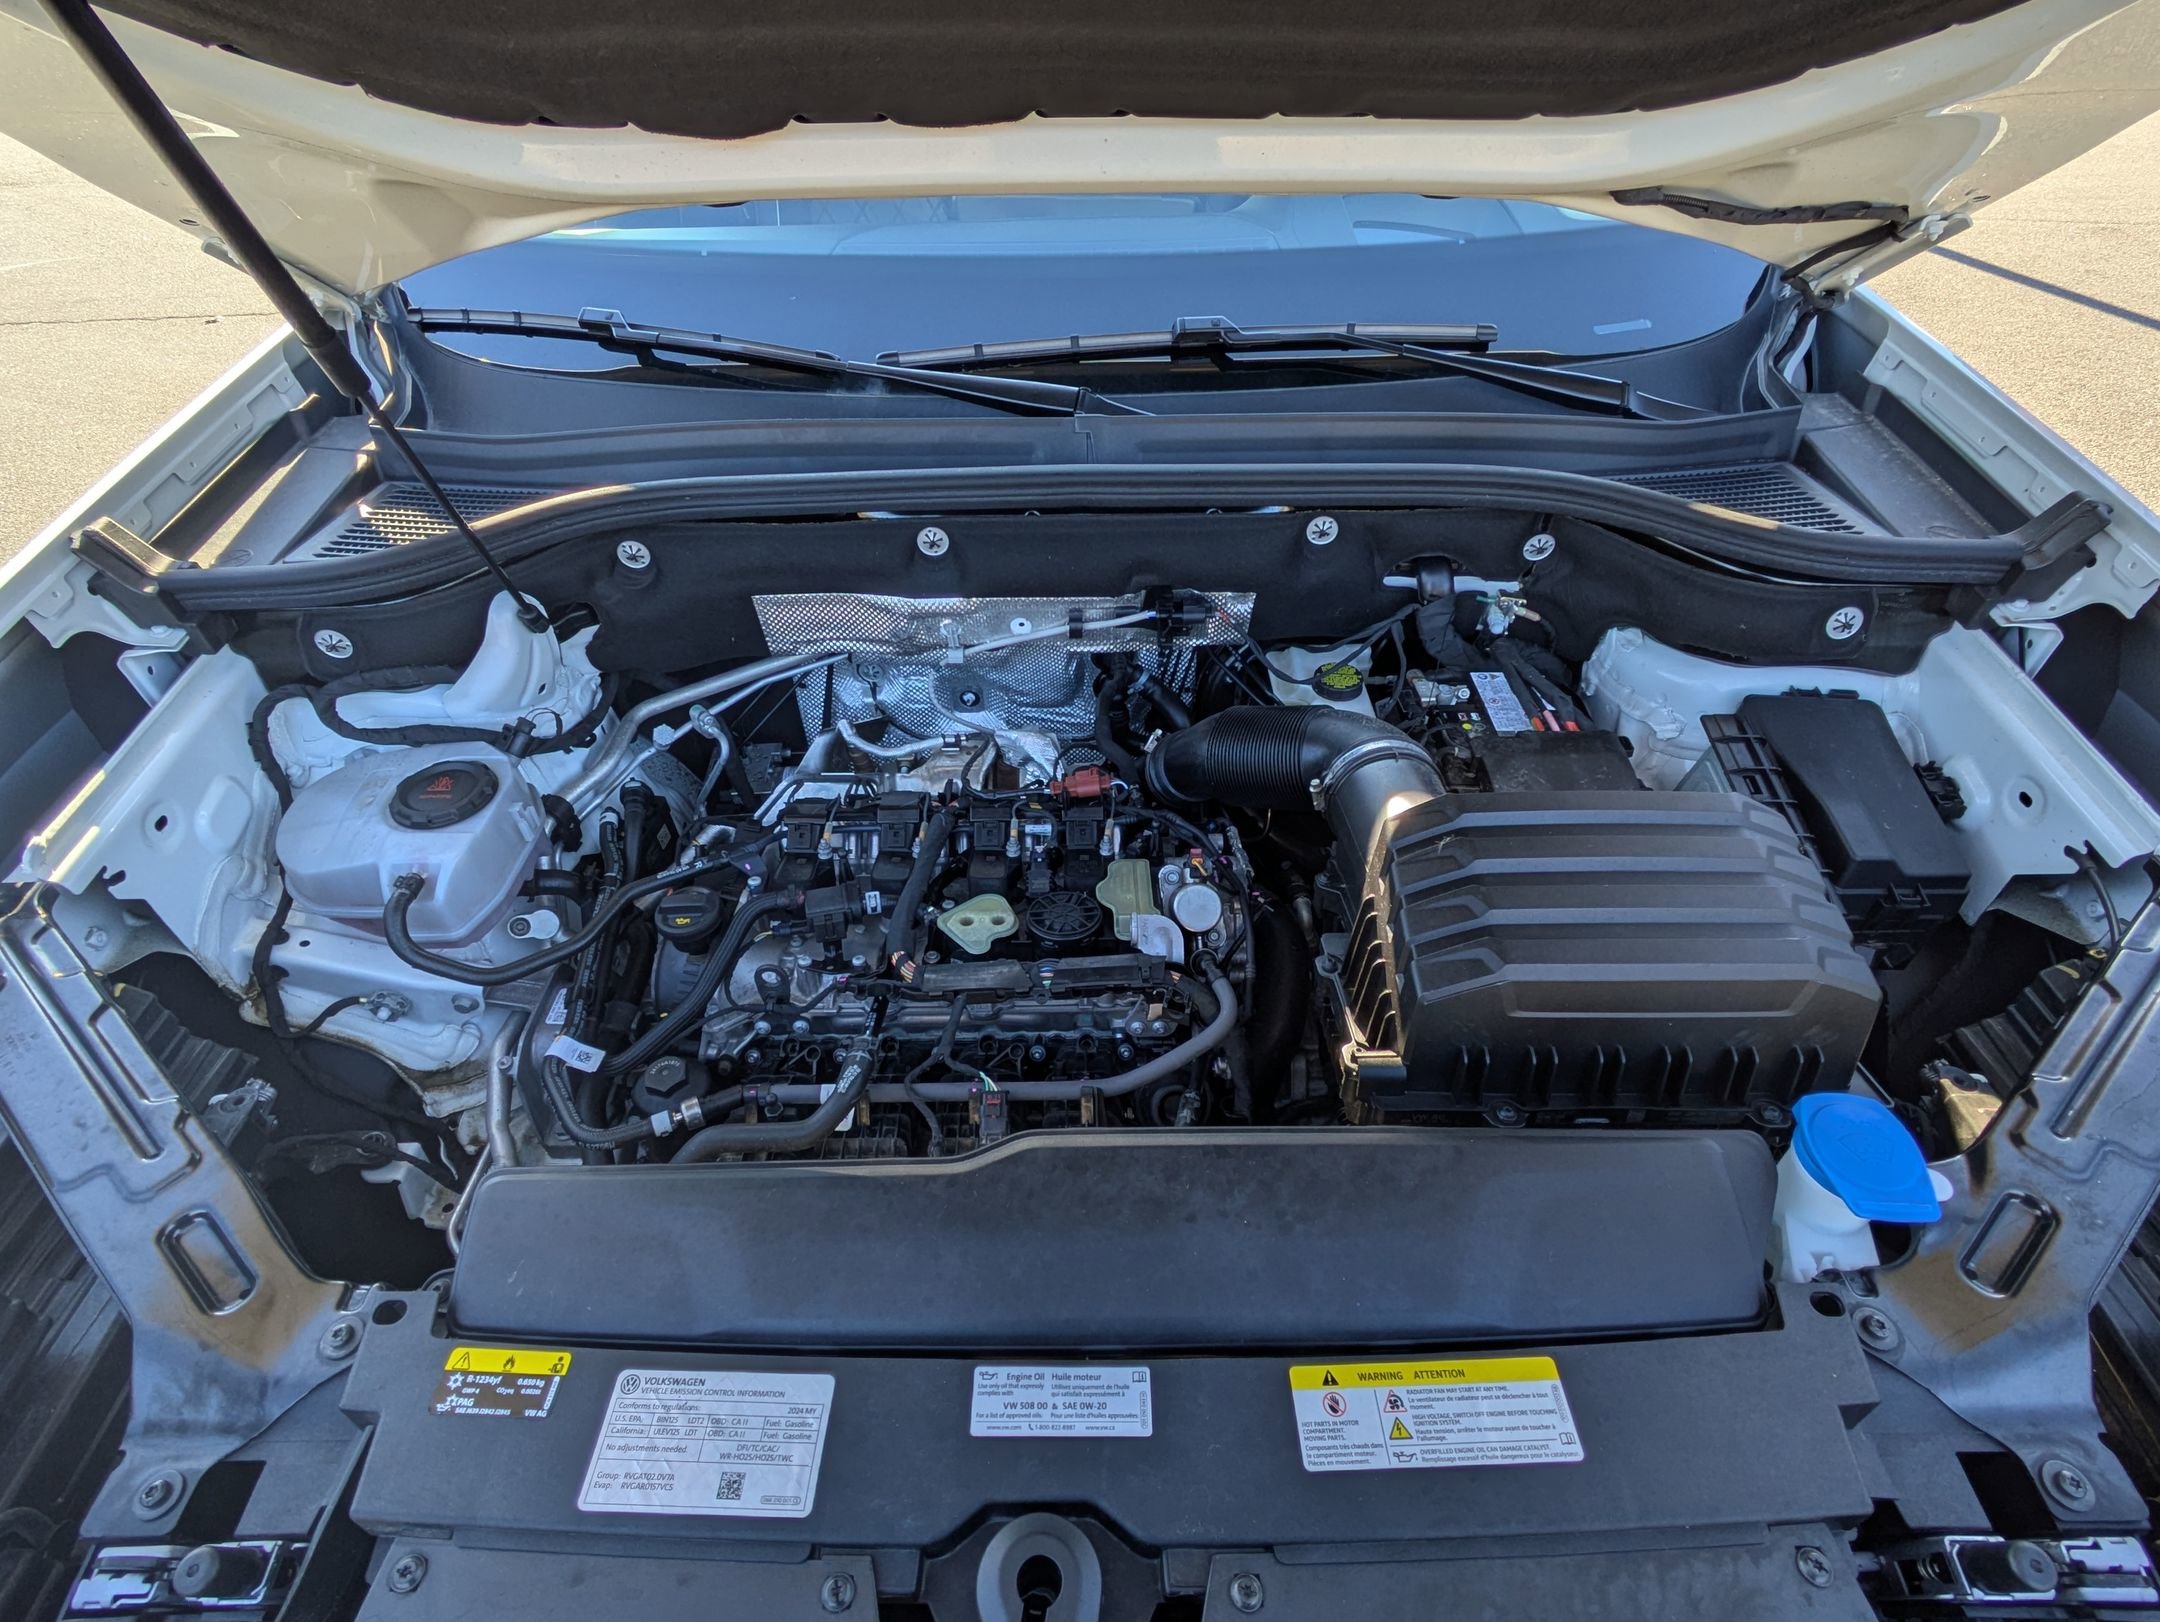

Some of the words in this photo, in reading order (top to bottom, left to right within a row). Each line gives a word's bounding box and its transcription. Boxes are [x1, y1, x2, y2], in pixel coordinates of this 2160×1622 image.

[1007, 1373, 1032, 1382] Engine
[1357, 1371, 1403, 1382] WARNING
[1414, 1369, 1465, 1380] ATTENTION
[467, 1375, 502, 1385] R-1234yf
[536, 1379, 545, 1387] kg
[644, 1377, 705, 1386] VOLKSWAGEN
[1062, 1402, 1077, 1410] SAE
[1080, 1402, 1107, 1410] 0W-20
[537, 1410, 547, 1418] AG
[785, 1420, 814, 1428] Gasoline
[617, 1444, 660, 1453] adjustments
[597, 1472, 621, 1480] Group:
[594, 1481, 613, 1489] Evap:
